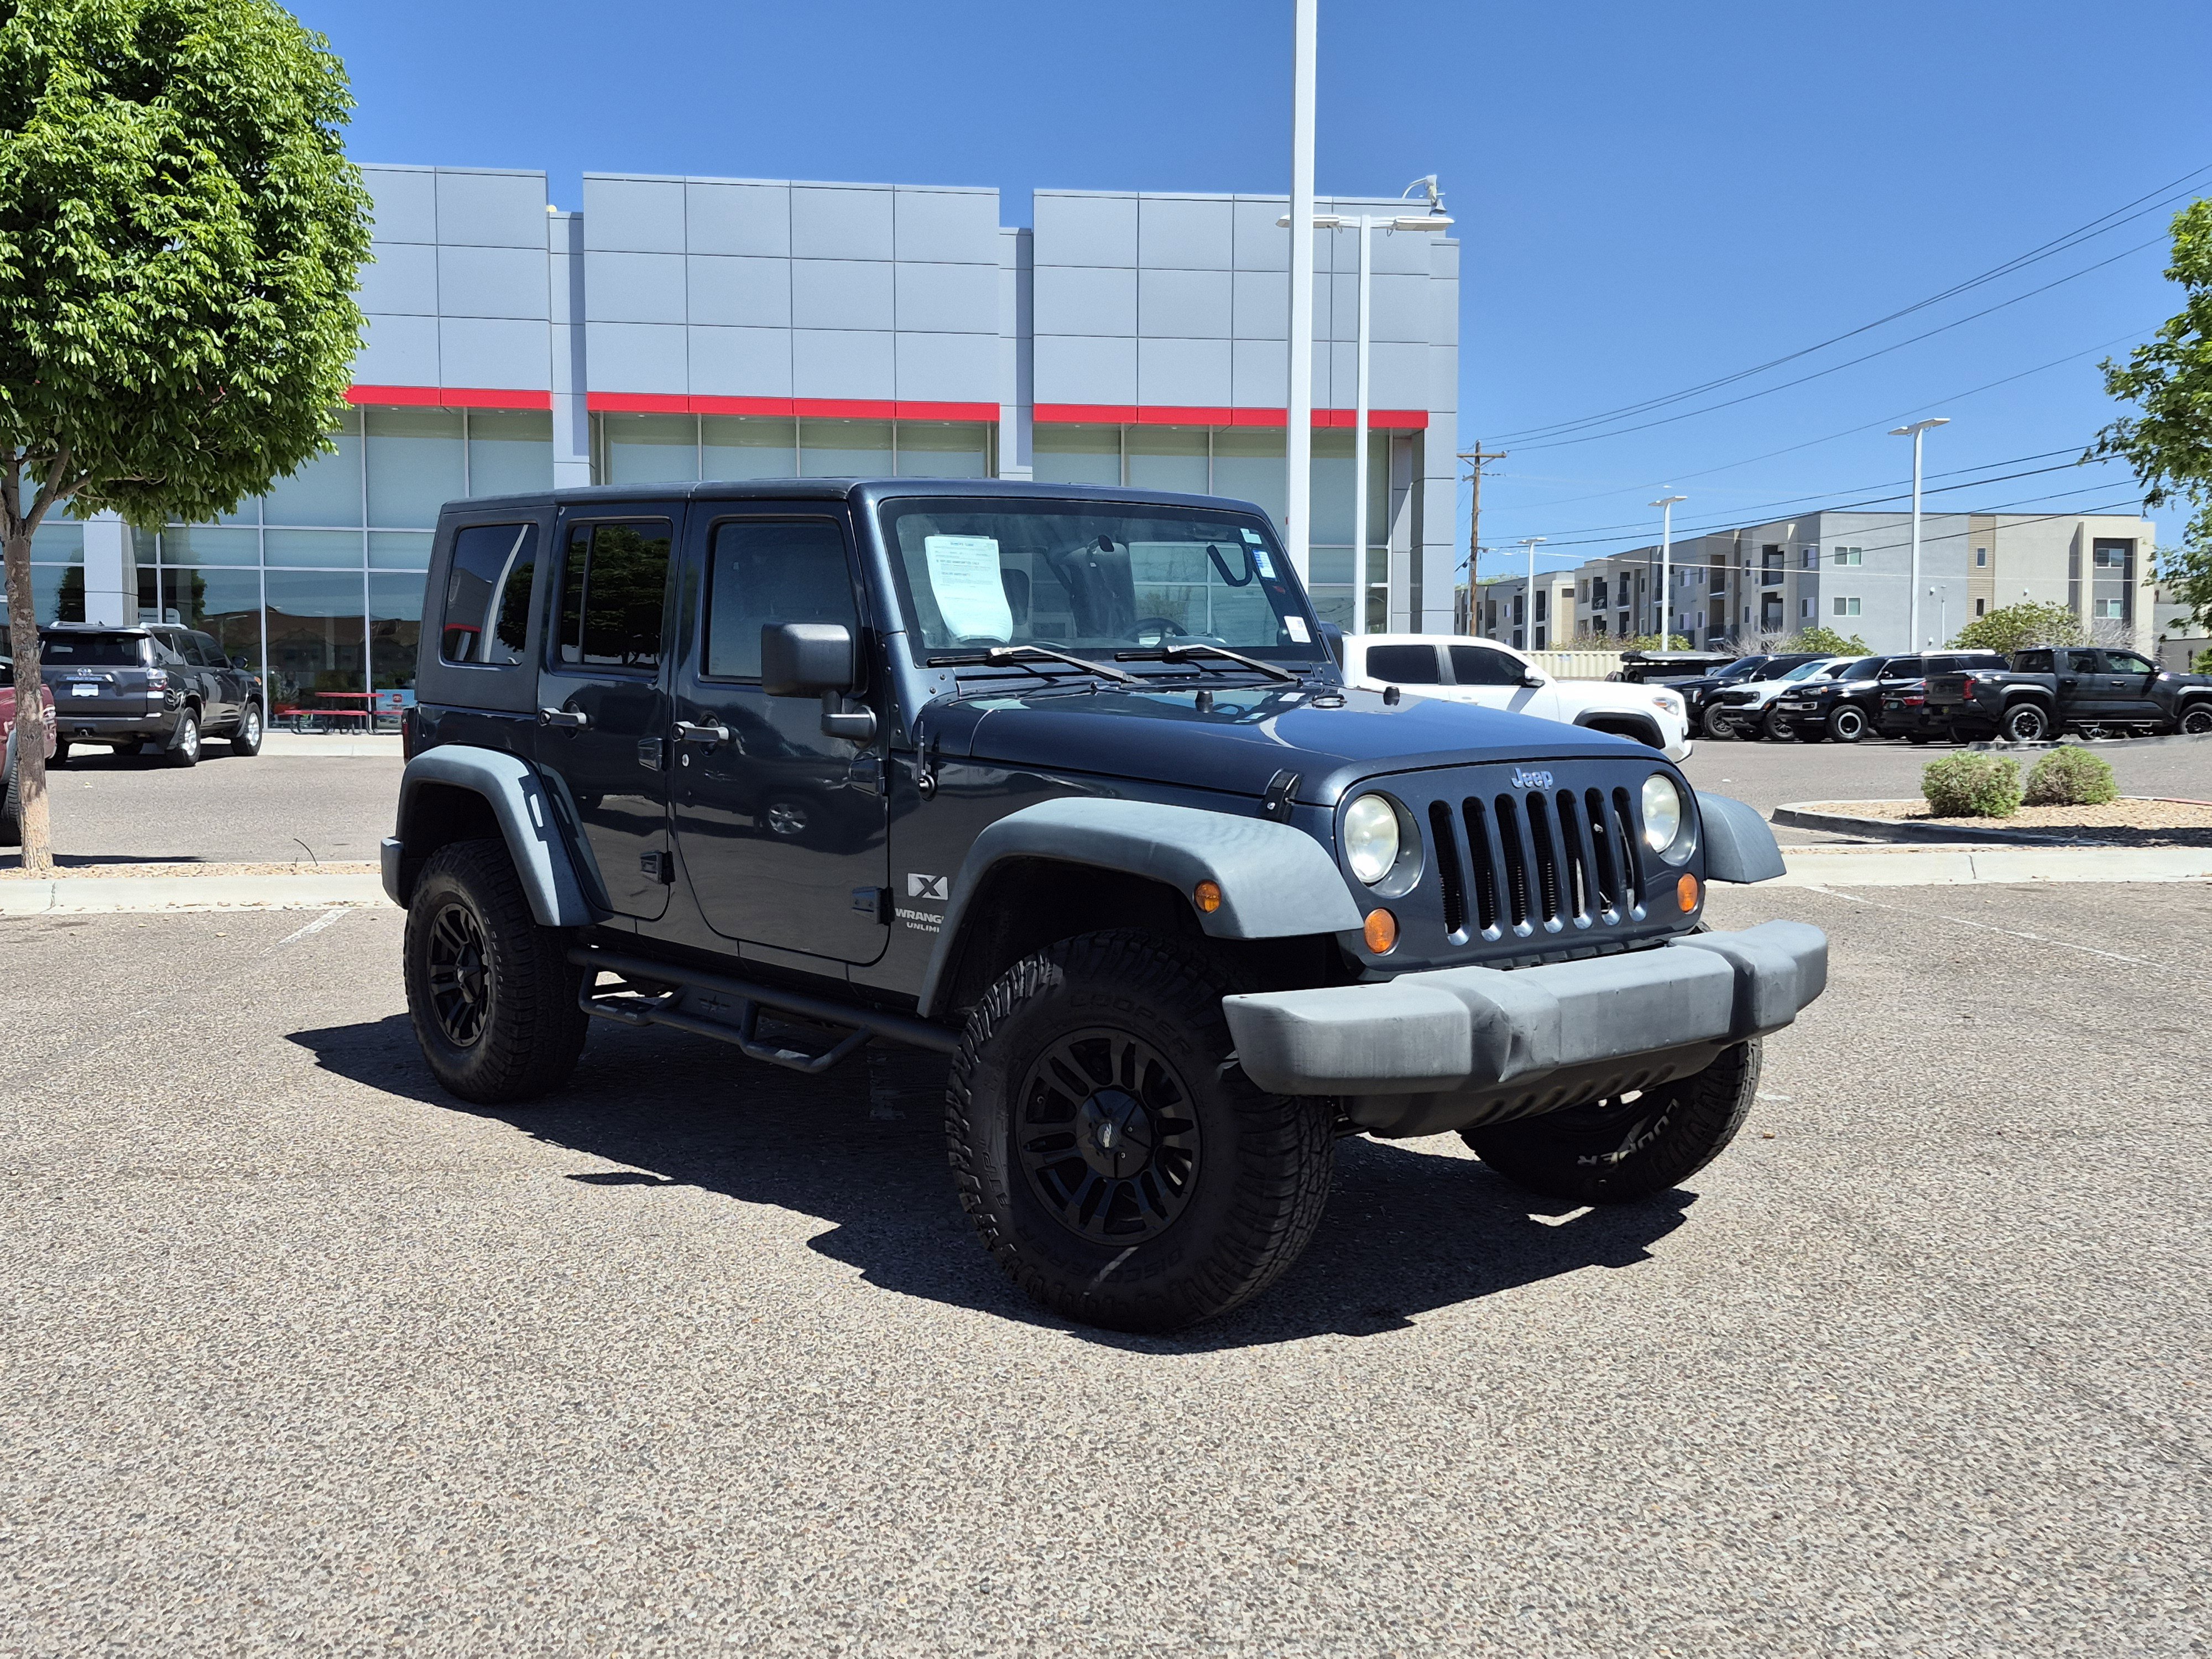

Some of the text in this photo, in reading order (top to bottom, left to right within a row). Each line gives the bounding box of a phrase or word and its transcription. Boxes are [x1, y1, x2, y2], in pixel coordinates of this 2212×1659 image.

[1511, 768, 1554, 791] Jeep
[911, 873, 945, 899] X
[895, 907, 944, 924] WRANG
